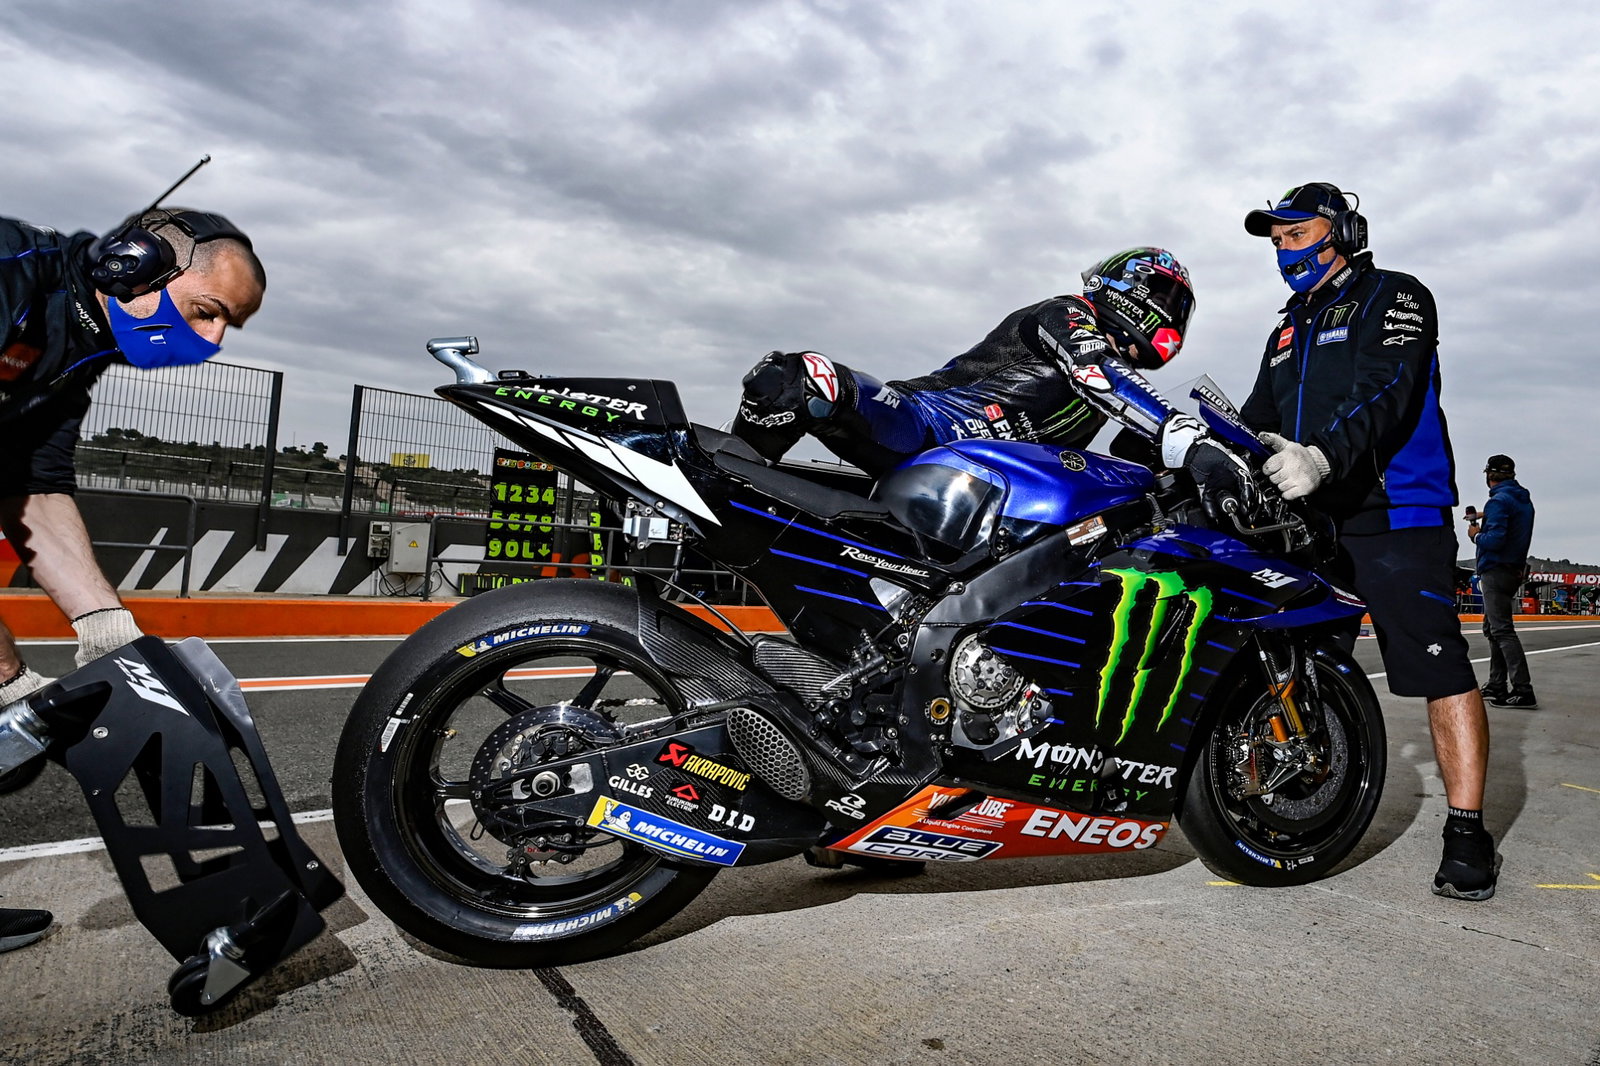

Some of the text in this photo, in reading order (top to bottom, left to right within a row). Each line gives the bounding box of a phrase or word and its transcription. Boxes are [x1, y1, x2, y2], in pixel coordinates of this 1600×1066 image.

[1105, 288, 1144, 319] MONSTER
[1403, 301, 1420, 310] CRU
[75, 301, 101, 334] ONSTER
[0, 355, 30, 369] NEOS
[1109, 360, 1173, 412] YAMAHA
[494, 386, 620, 423] ENERGY
[513, 384, 648, 421] NSTER
[1199, 386, 1229, 411] KELOS
[1528, 573, 1600, 585] OTUL MOT
[492, 623, 583, 645] MICHELIN
[608, 775, 654, 799] GILLES
[664, 794, 699, 810] FURUKAWA
[666, 800, 693, 813] ELECTRIC
[824, 798, 867, 821] RCB
[633, 820, 731, 858] MICHELIN
[941, 821, 961, 830] Engine
[961, 824, 993, 835] Component
[1020, 808, 1164, 850] ENEOS
[864, 843, 968, 861] CORE
[883, 829, 987, 852] BLUE
[1237, 842, 1269, 865] MICHELIN
